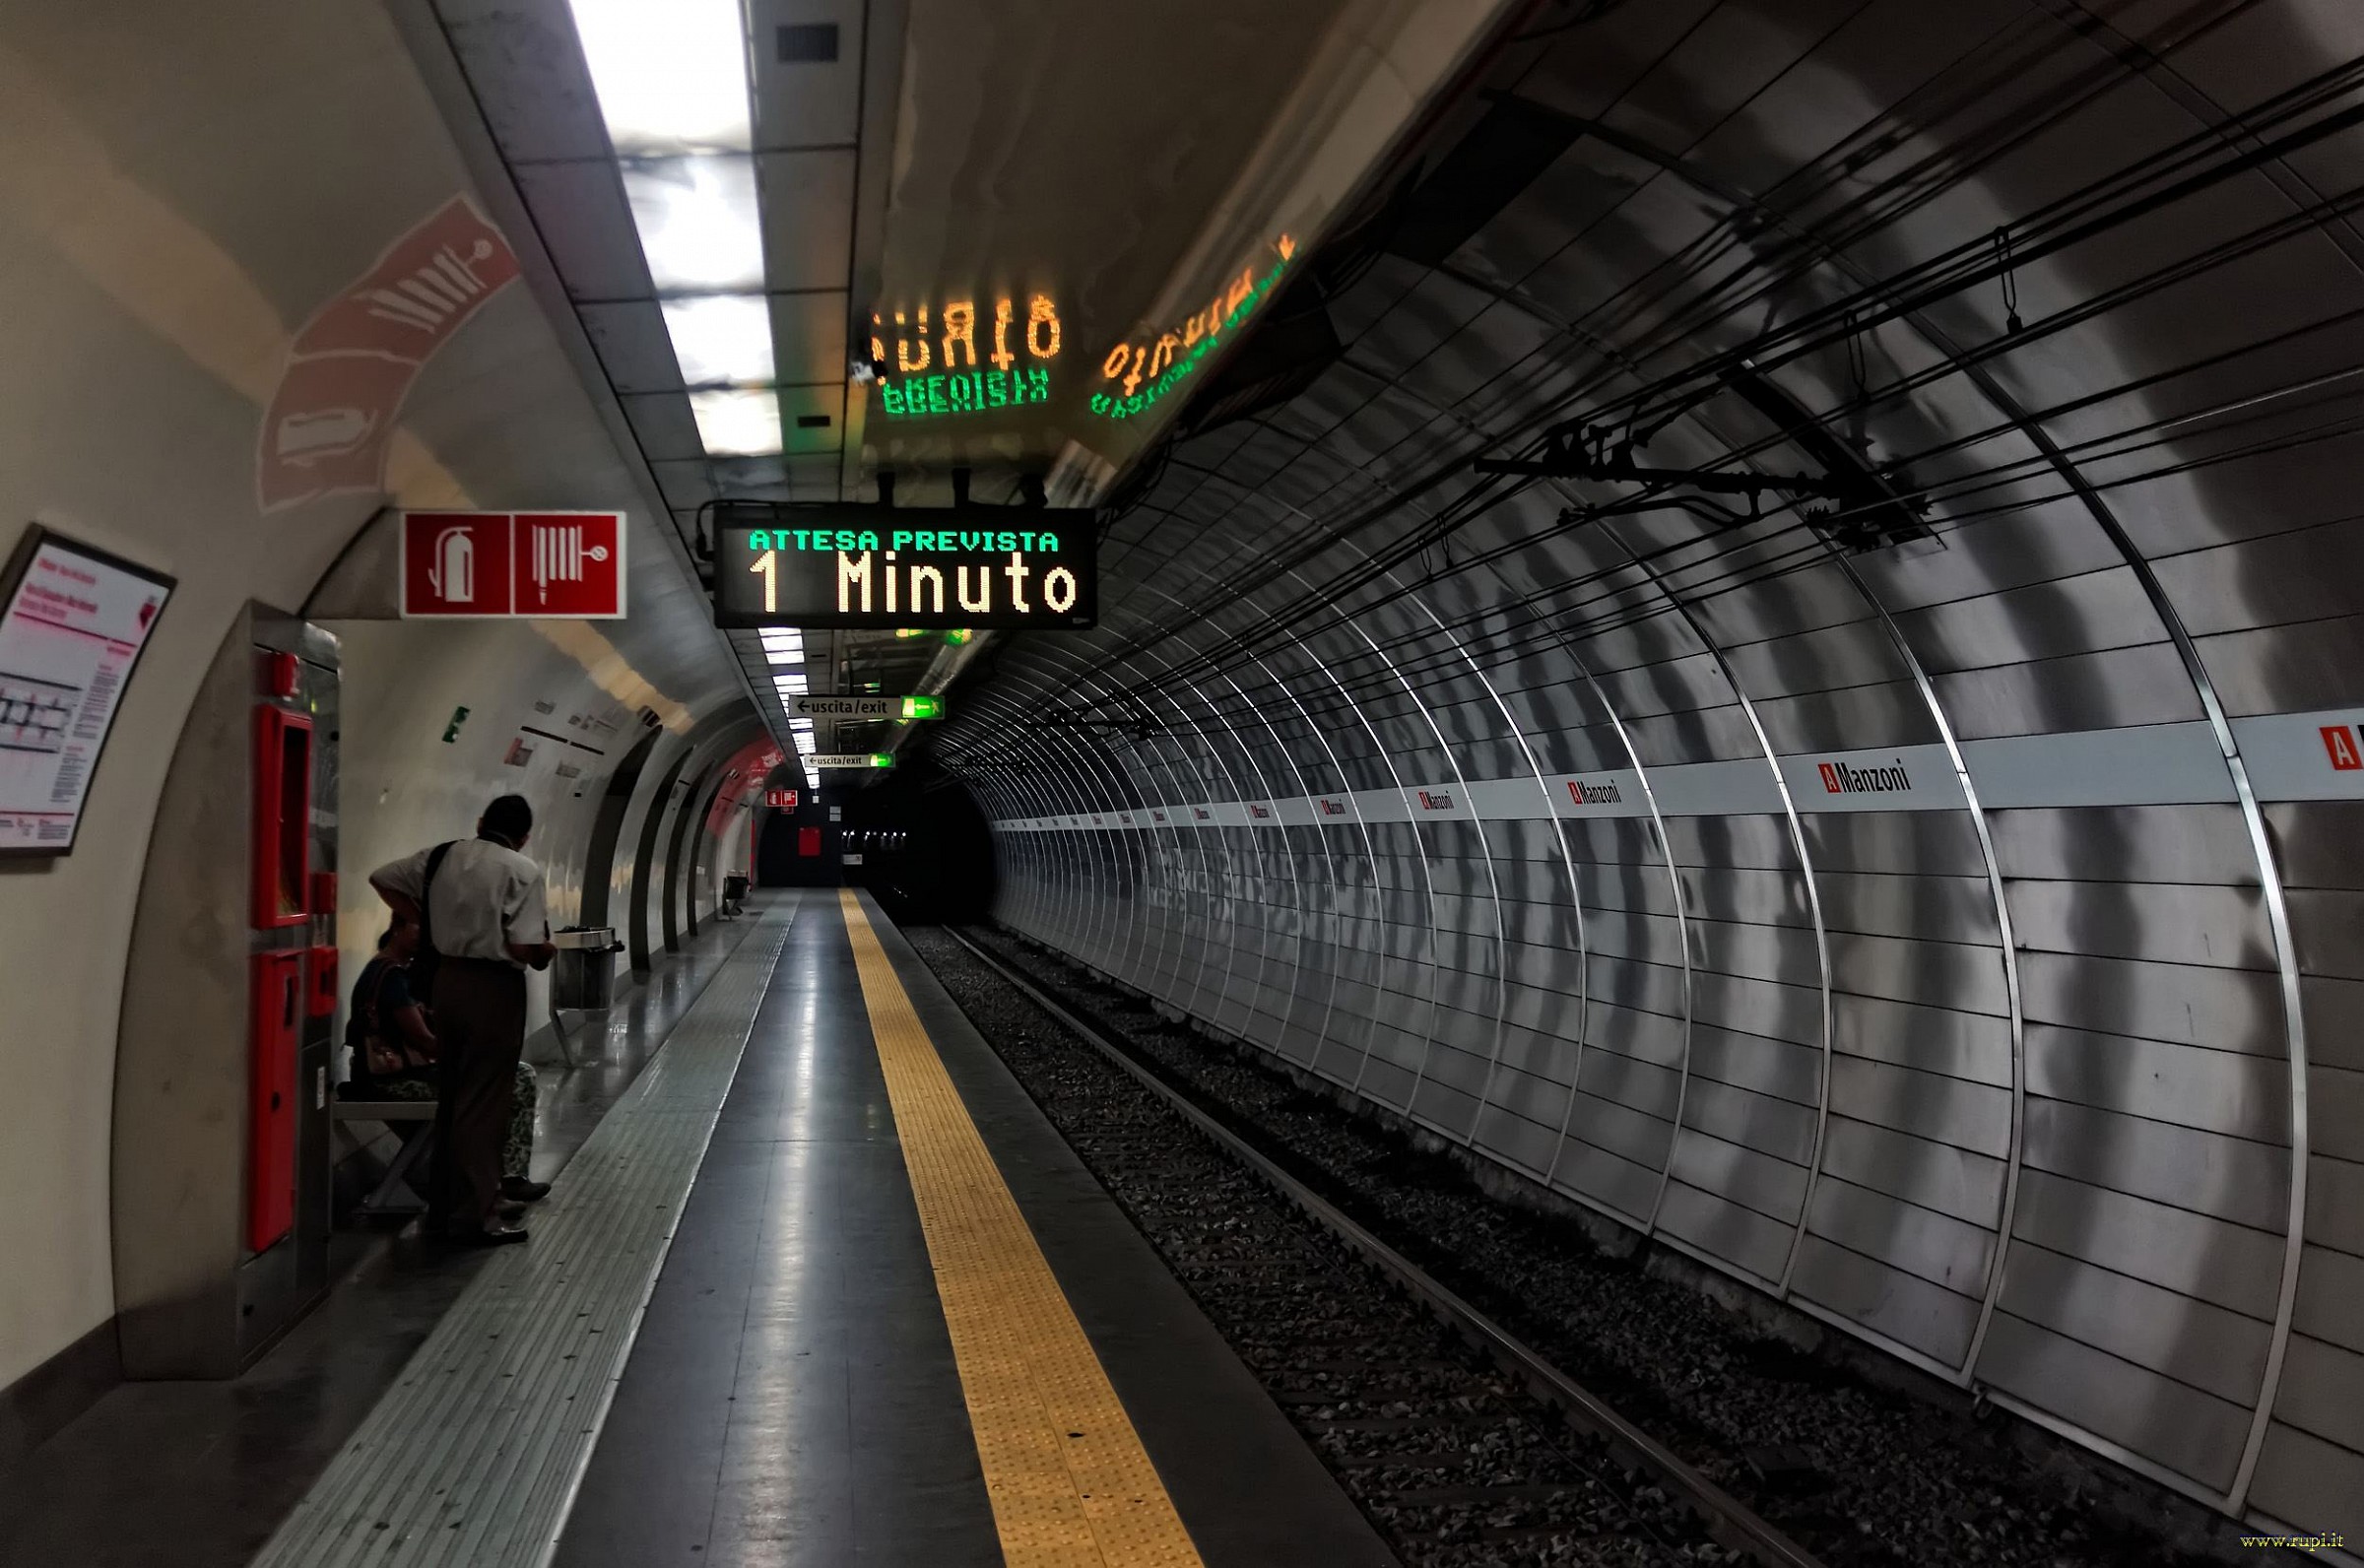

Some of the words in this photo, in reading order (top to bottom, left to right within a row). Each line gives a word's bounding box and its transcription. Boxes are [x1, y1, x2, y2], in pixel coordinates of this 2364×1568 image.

[749, 529, 879, 551] ATTESA
[892, 530, 1059, 553] PREVISTA
[750, 550, 776, 613] 1
[837, 551, 1077, 613] Minuto
[1834, 757, 1912, 793] Manzoni
[1576, 778, 1622, 805] Manzoni
